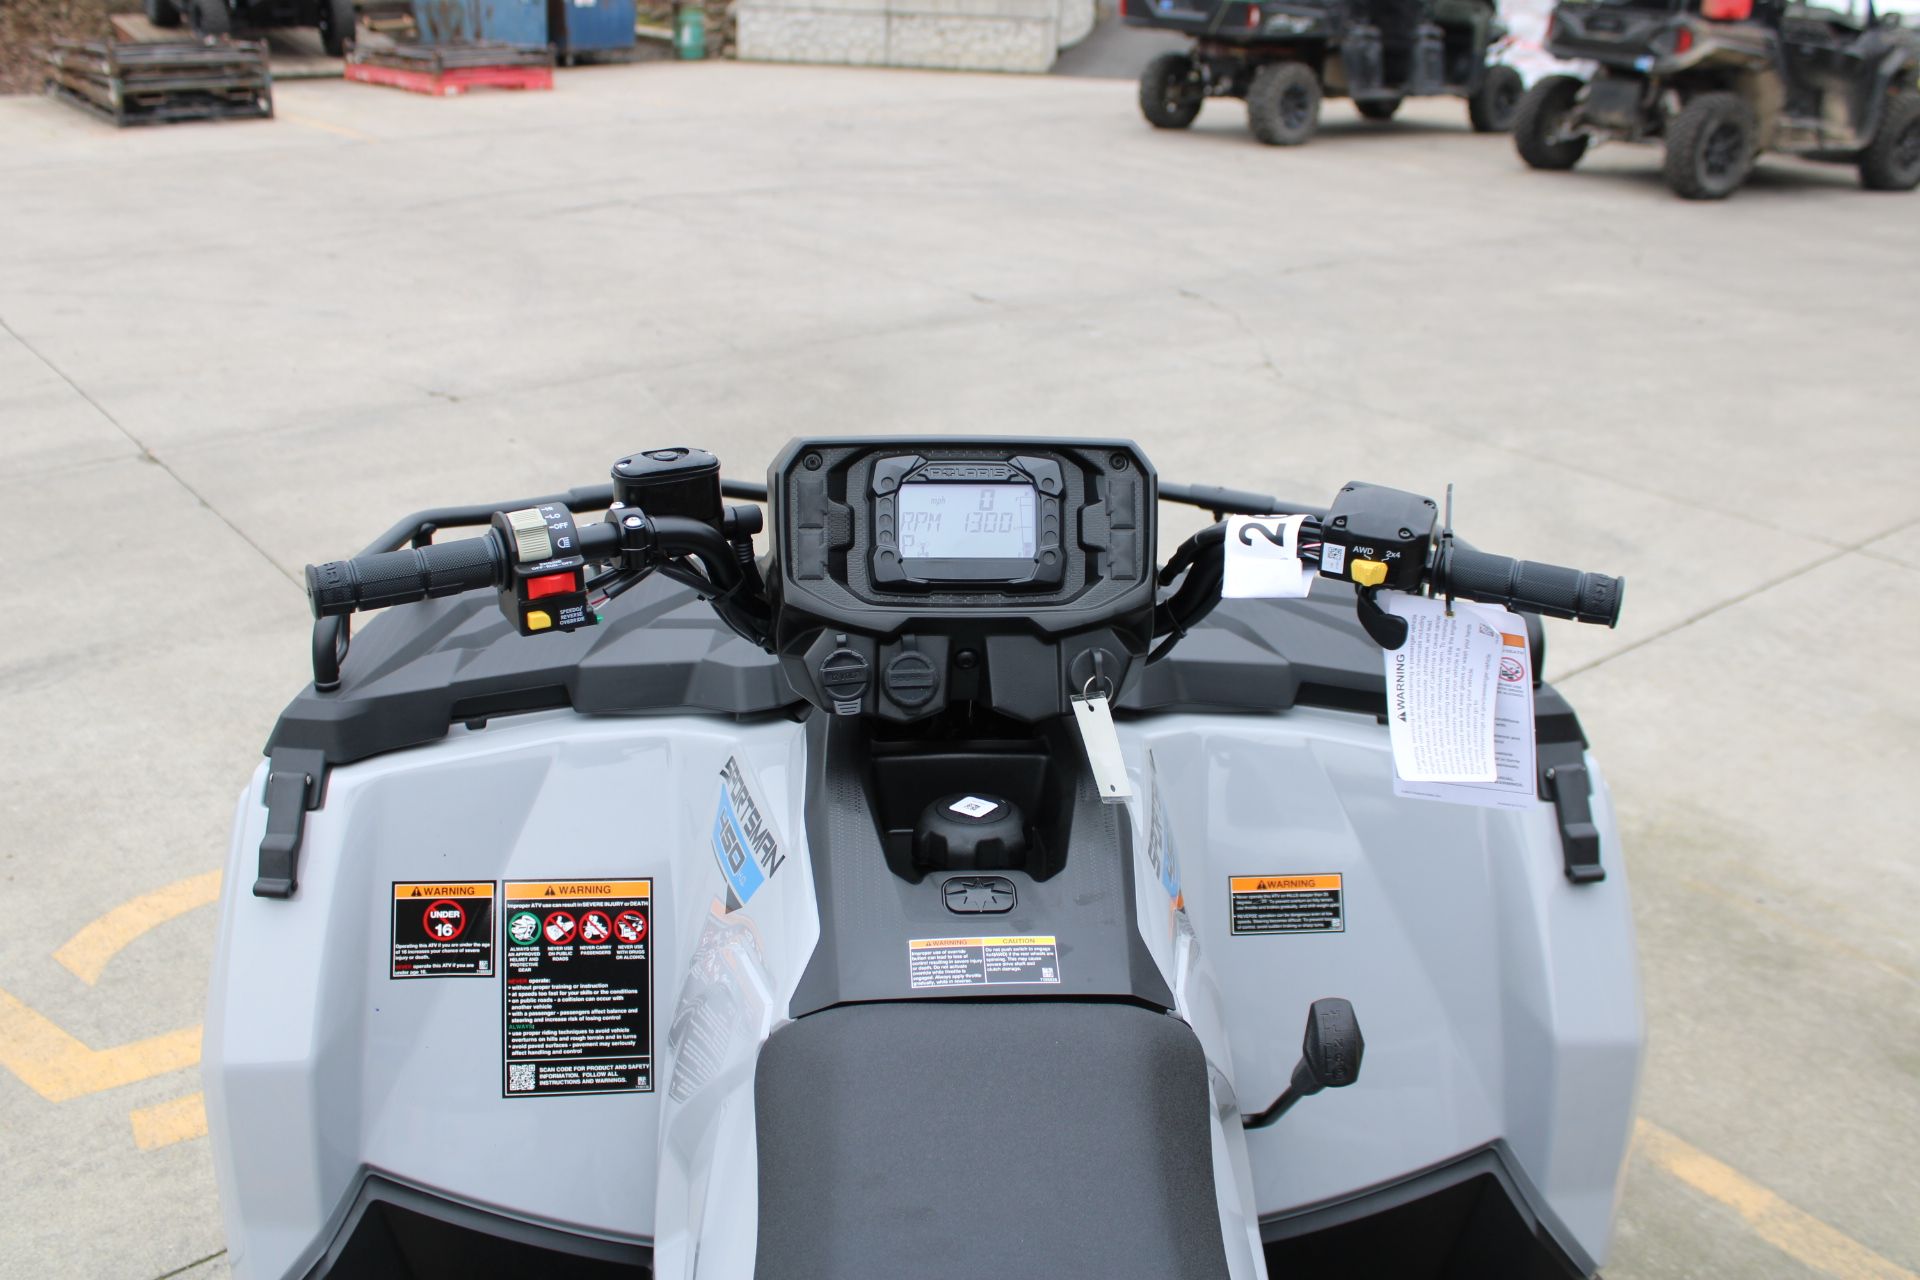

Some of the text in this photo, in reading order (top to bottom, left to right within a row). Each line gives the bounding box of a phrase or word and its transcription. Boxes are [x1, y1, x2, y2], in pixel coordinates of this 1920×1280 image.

[929, 467, 1008, 478] POLARIS
[979, 489, 994, 511] 0
[901, 512, 1013, 533] RPM 1300
[1353, 545, 1374, 555] AWD
[560, 612, 583, 620] REVERSE
[560, 617, 585, 625] OVERRIDE
[1396, 654, 1405, 710] WARNING
[720, 755, 786, 879] SPORTSMAN
[720, 807, 746, 876] 450
[559, 885, 611, 894] WARNING
[1267, 880, 1316, 889] WARNING
[424, 887, 475, 895] WARNING
[435, 924, 453, 936] 16
